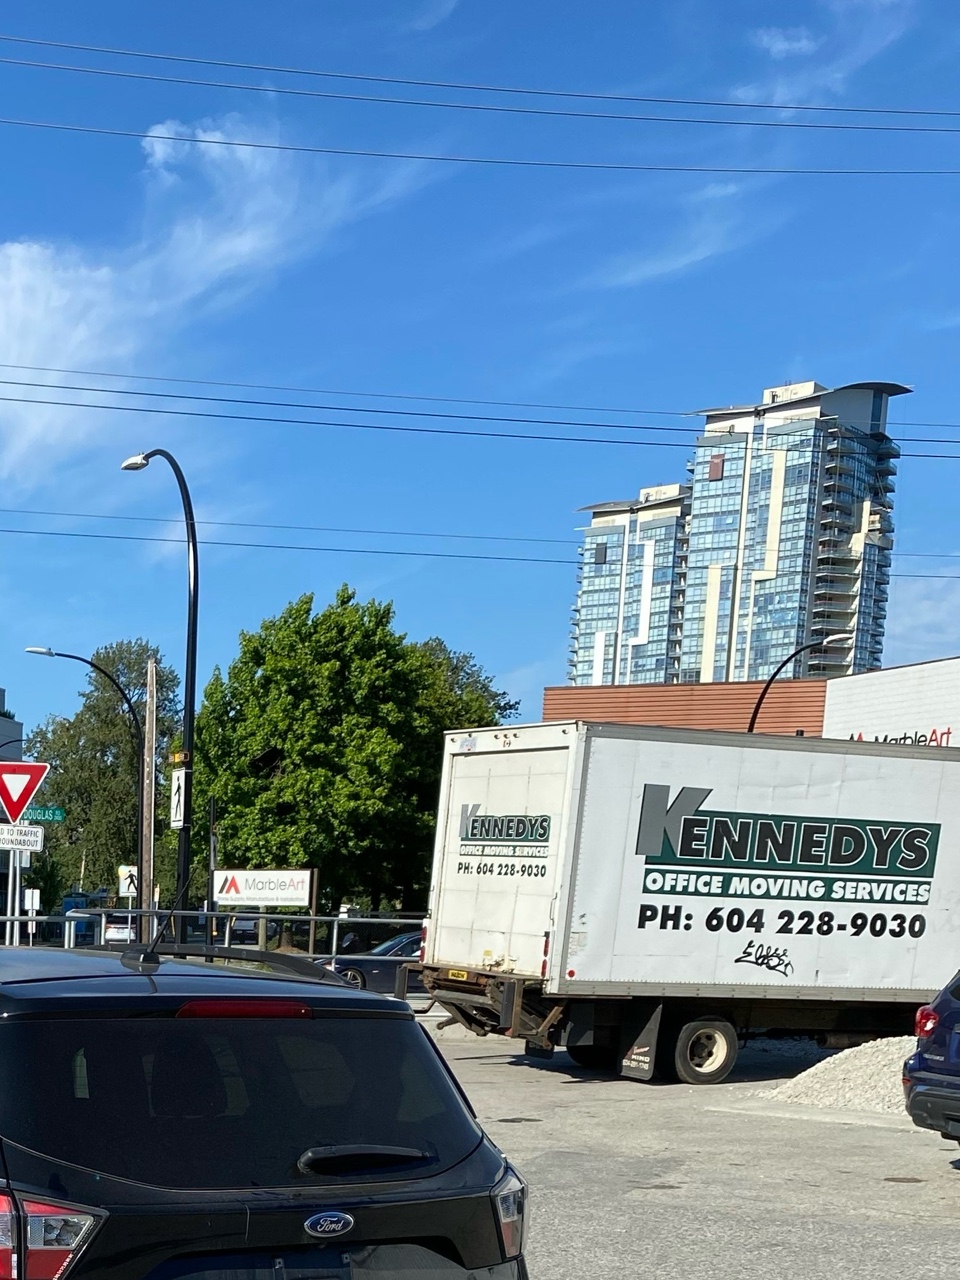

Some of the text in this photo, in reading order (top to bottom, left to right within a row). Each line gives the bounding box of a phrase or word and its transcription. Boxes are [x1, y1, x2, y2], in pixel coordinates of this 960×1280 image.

[23, 810, 53, 820] DOUGLAS
[459, 804, 550, 840] KENNEDYS
[6, 828, 15, 836] TO
[16, 829, 40, 838] TRAFFIC
[635, 783, 932, 871] KENNEDYS
[460, 845, 550, 857] OFFICE MOVING SERVICES
[457, 862, 547, 877] PH: 604 228-9030
[244, 877, 306, 891] MarbleArt
[645, 872, 931, 903] OFFICE MOVING SERVICES
[637, 903, 927, 938] PH: 604 228-9030
[317, 1217, 344, 1231] Ford
